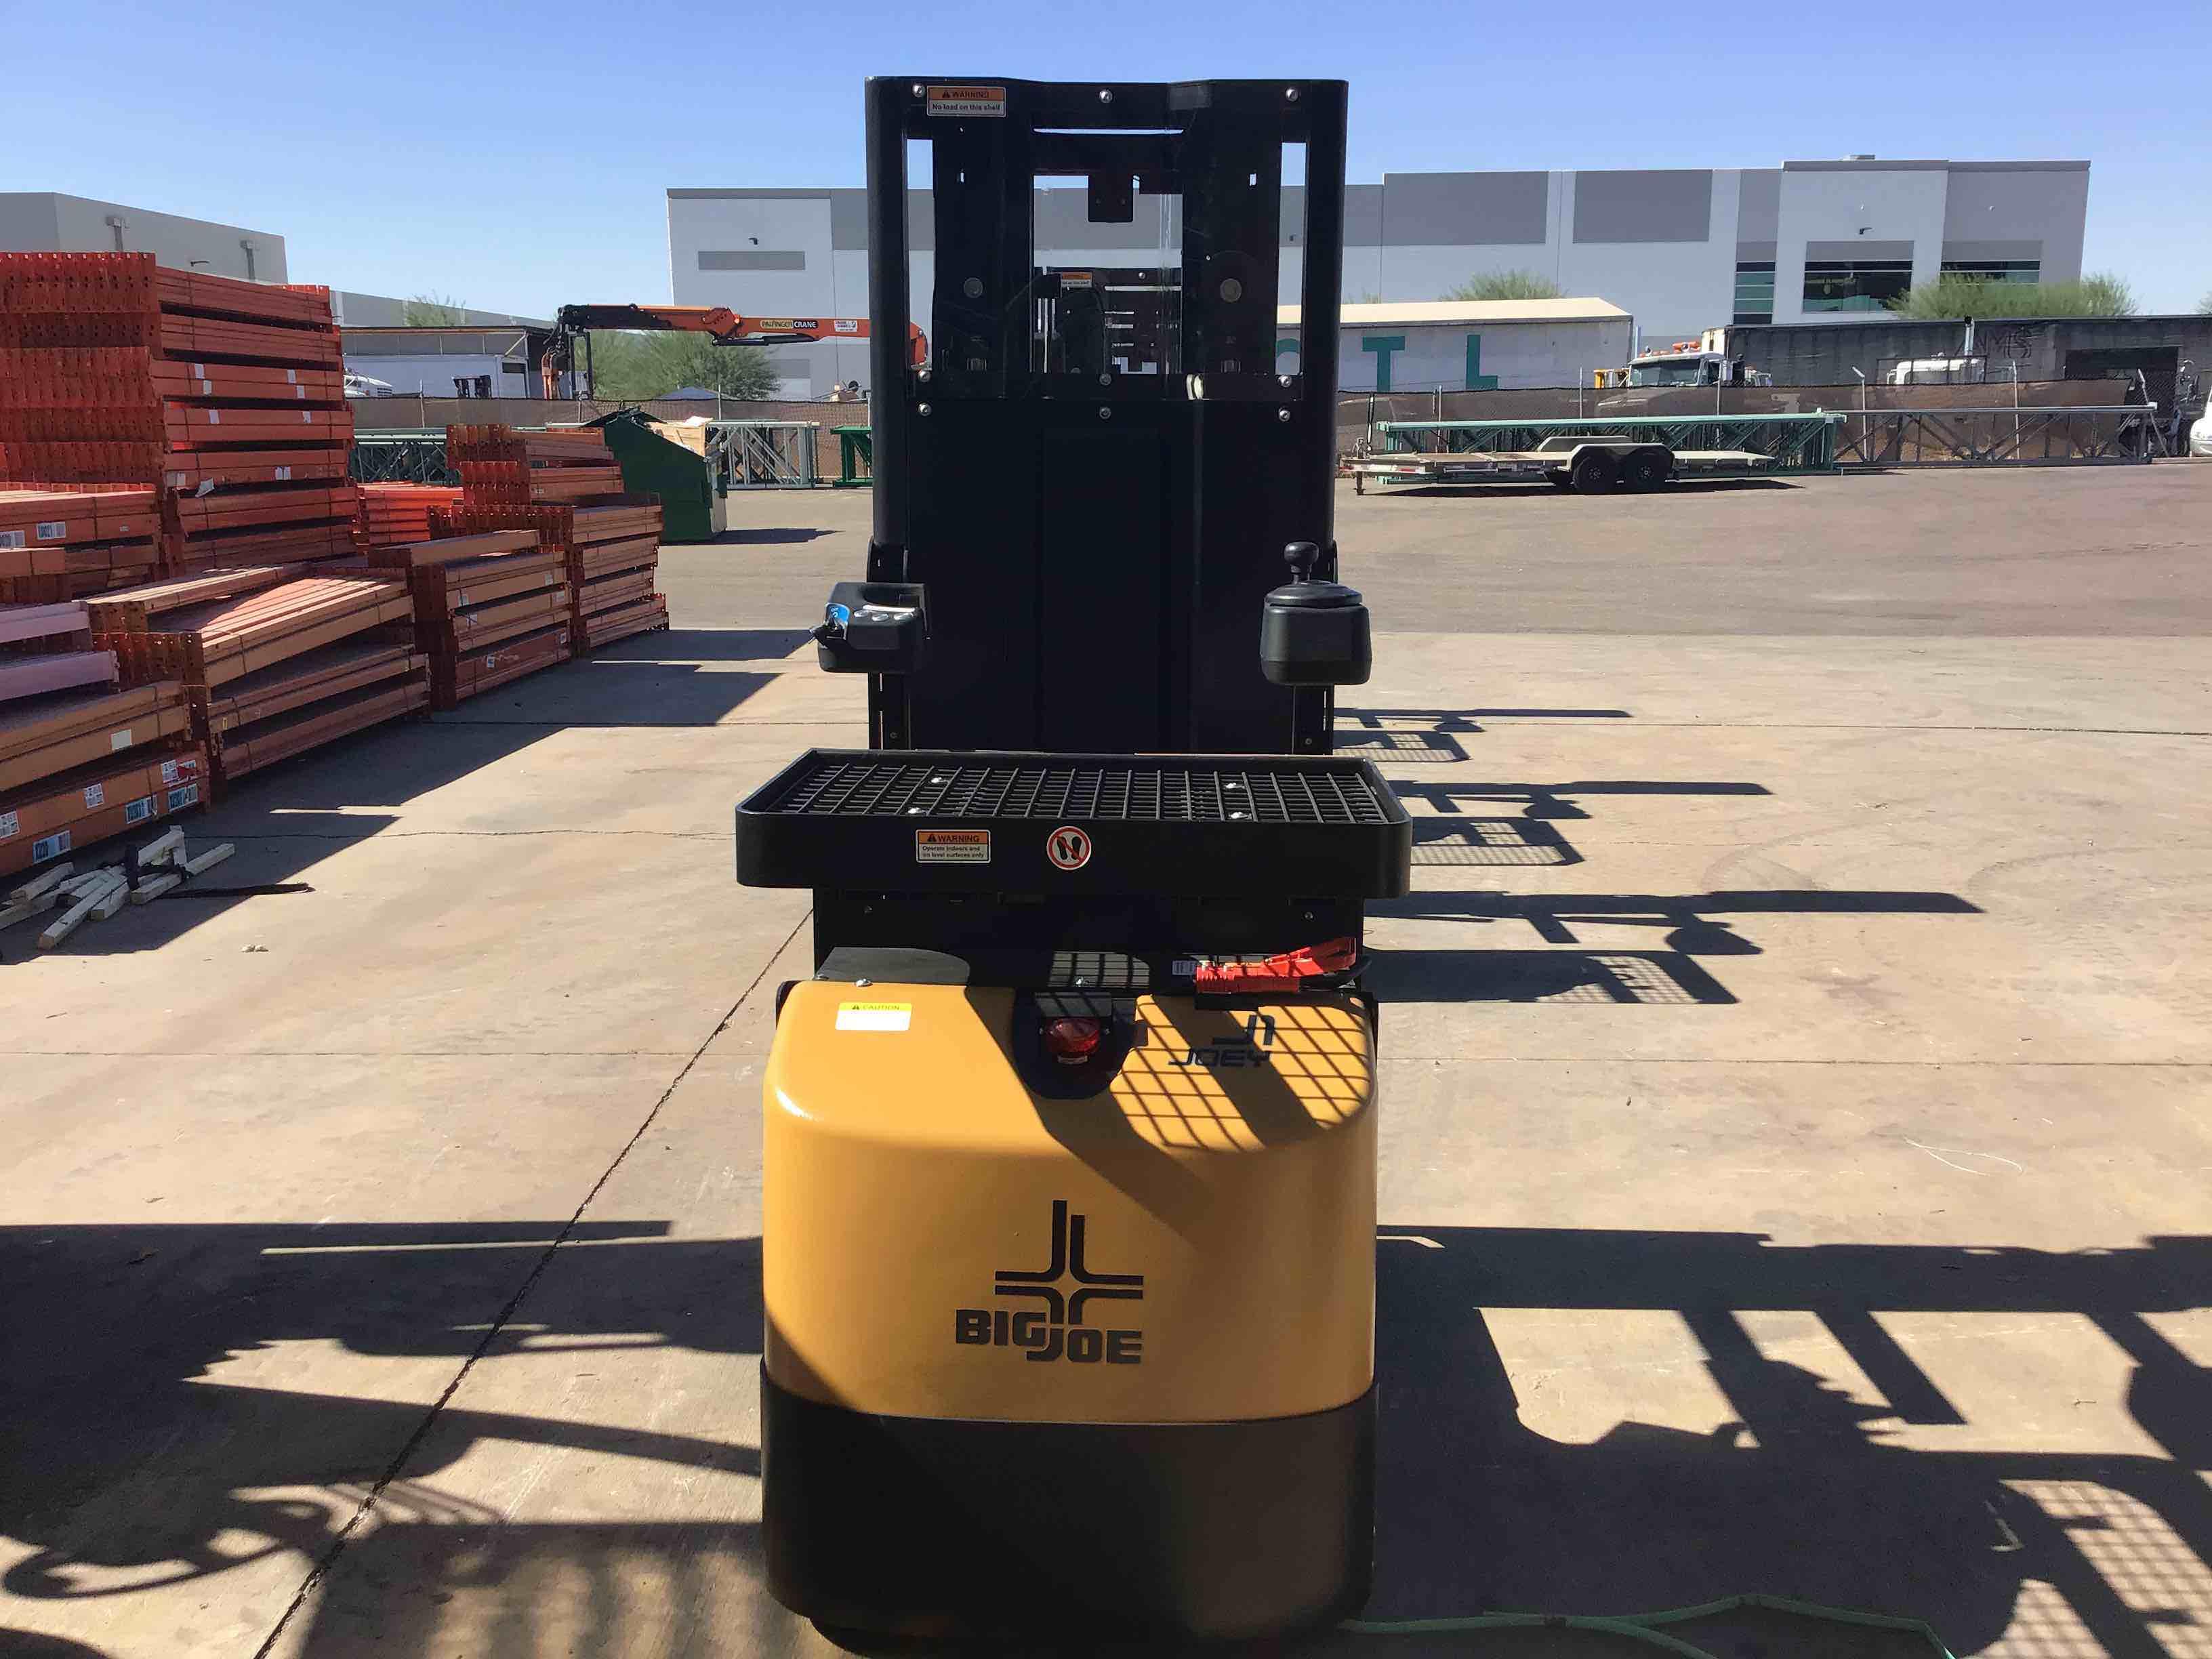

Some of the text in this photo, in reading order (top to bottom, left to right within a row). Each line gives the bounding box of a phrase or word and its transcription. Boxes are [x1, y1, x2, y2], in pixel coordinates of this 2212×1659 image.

[1168, 1048, 1271, 1067] JOEY
[956, 1309, 1143, 1365] BIG JOE
